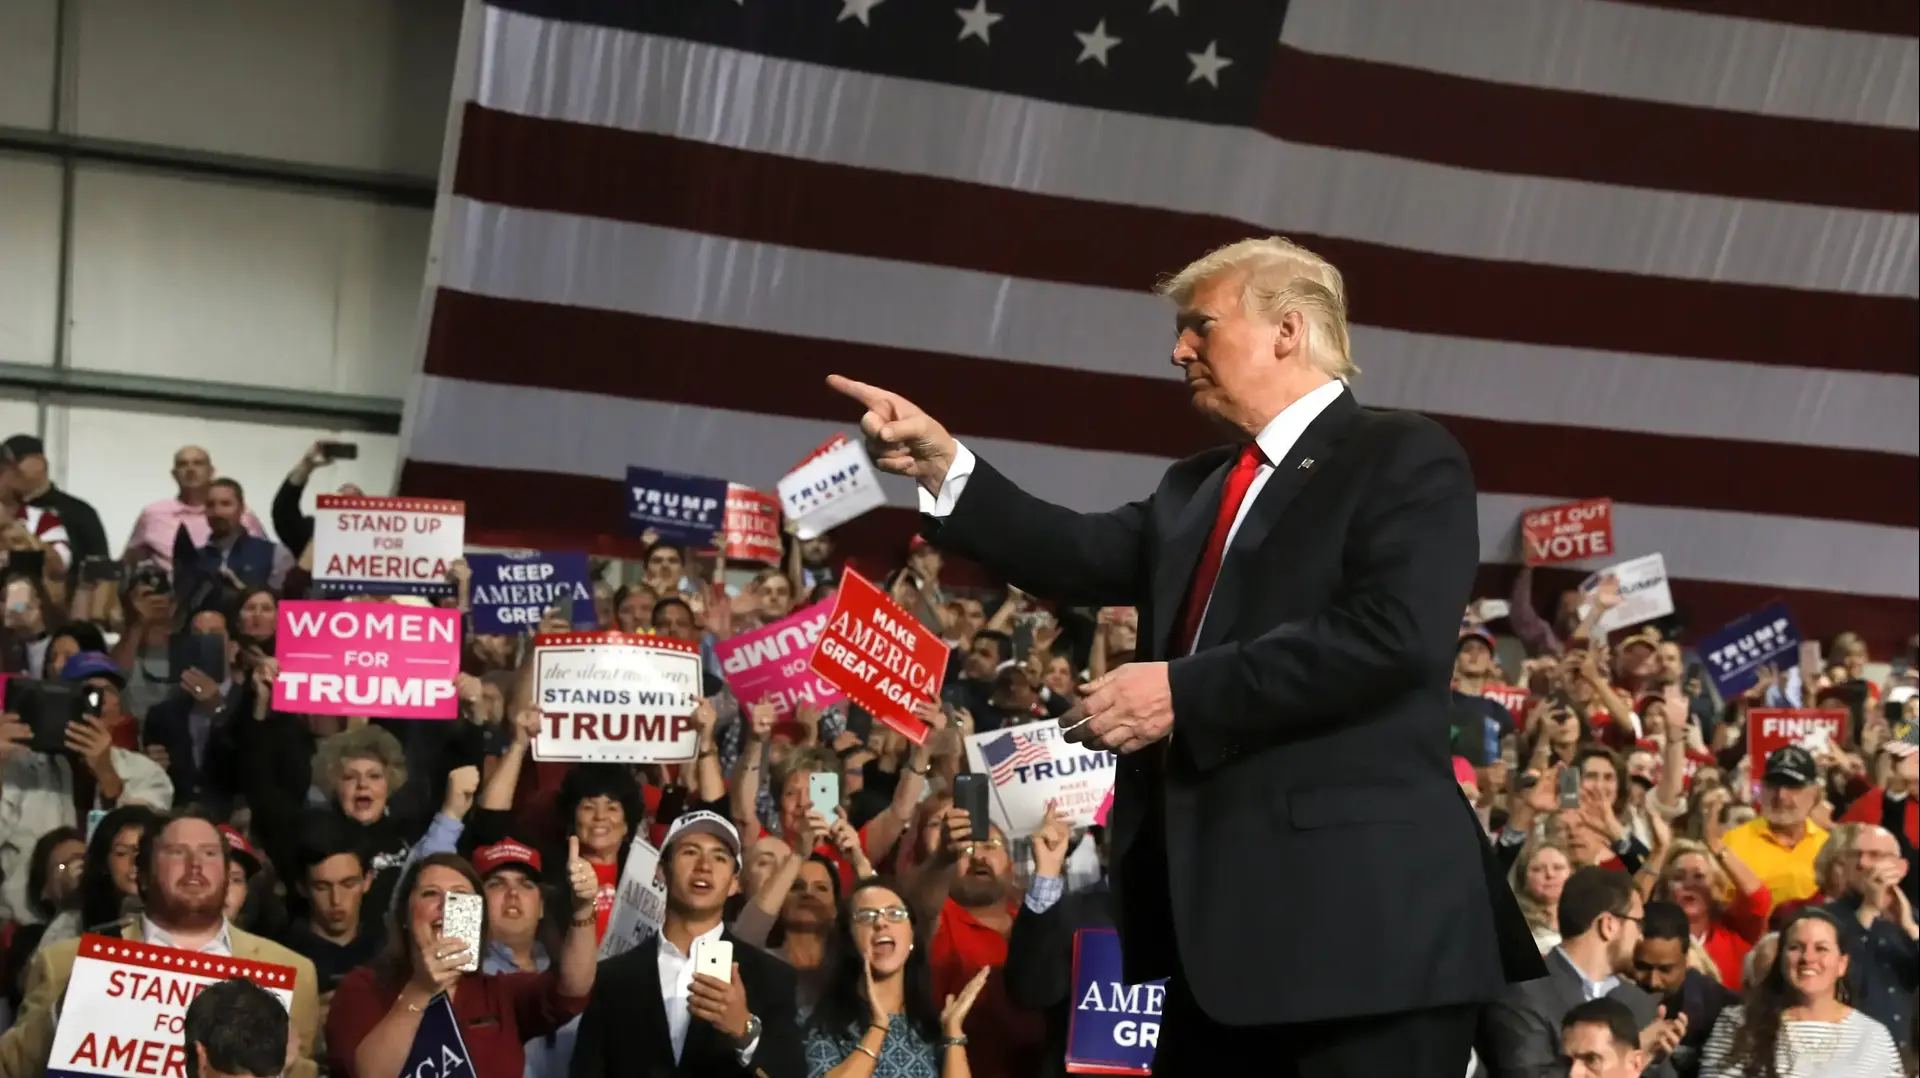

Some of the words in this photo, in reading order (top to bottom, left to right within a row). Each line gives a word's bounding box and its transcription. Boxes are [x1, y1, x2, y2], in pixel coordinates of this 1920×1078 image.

[631, 486, 718, 511] TRUMP
[790, 463, 859, 505] TRUMP
[338, 513, 408, 533] STAND
[414, 516, 441, 534] UP
[637, 502, 708, 522] PENCE
[1526, 509, 1563, 528] GET
[1568, 504, 1606, 522] OUT
[373, 537, 404, 549] FOR
[1534, 530, 1607, 559] VOTE
[326, 553, 448, 579] AMERICA
[497, 563, 554, 582] KEEP
[286, 611, 455, 643] WOMEN
[872, 607, 917, 652] MAKE
[829, 610, 936, 695] AMERICA
[1708, 618, 1789, 666] TRUMP
[344, 650, 389, 668] FOR
[821, 637, 879, 683] GREAT
[277, 671, 457, 707] TRUMP
[544, 688, 631, 705] STANDS
[543, 712, 696, 742] TRUMP
[1113, 1020, 1160, 1048] GR
[69, 1032, 187, 1078] AMER
[405, 1044, 464, 1078] CA
